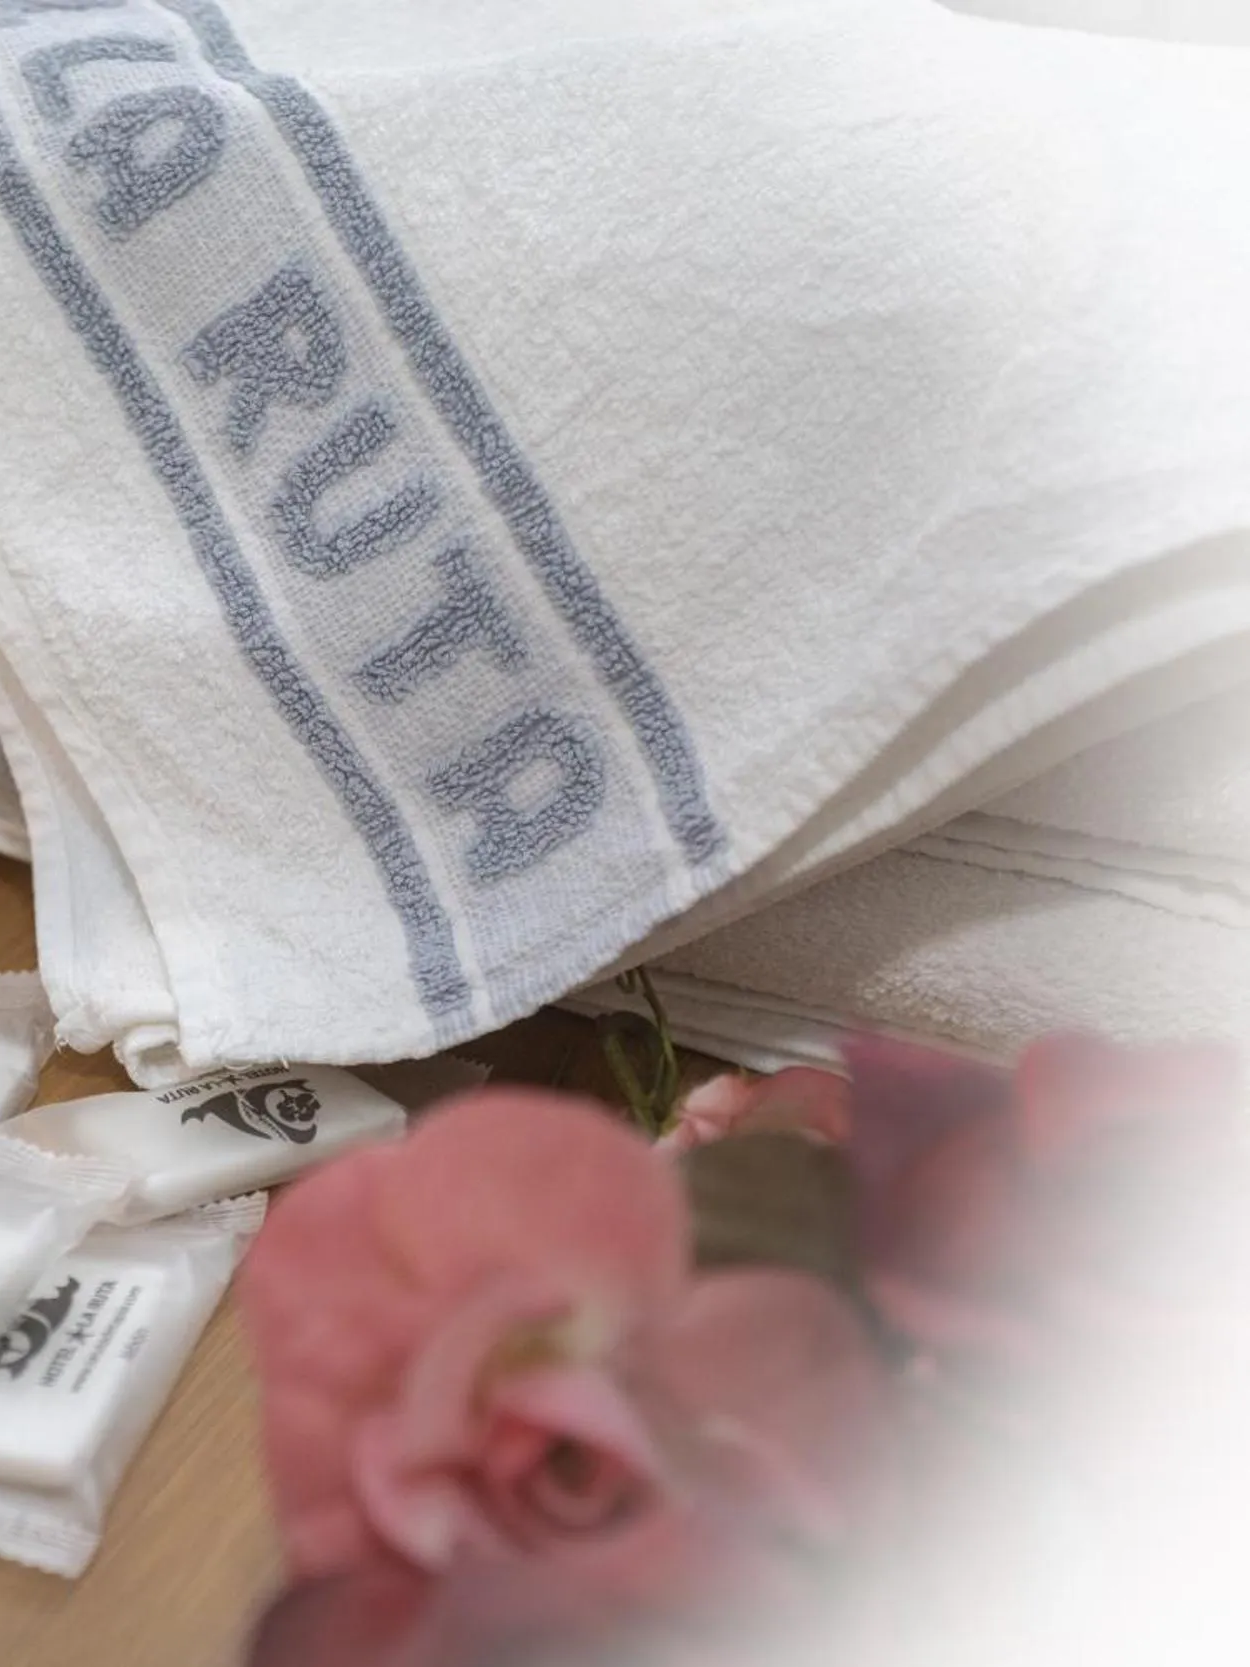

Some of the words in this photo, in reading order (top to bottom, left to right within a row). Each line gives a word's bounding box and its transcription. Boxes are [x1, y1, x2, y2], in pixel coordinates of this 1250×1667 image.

[19, 34, 226, 242] LA
[177, 253, 607, 884] RUTA
[156, 1084, 200, 1105] RUTA
